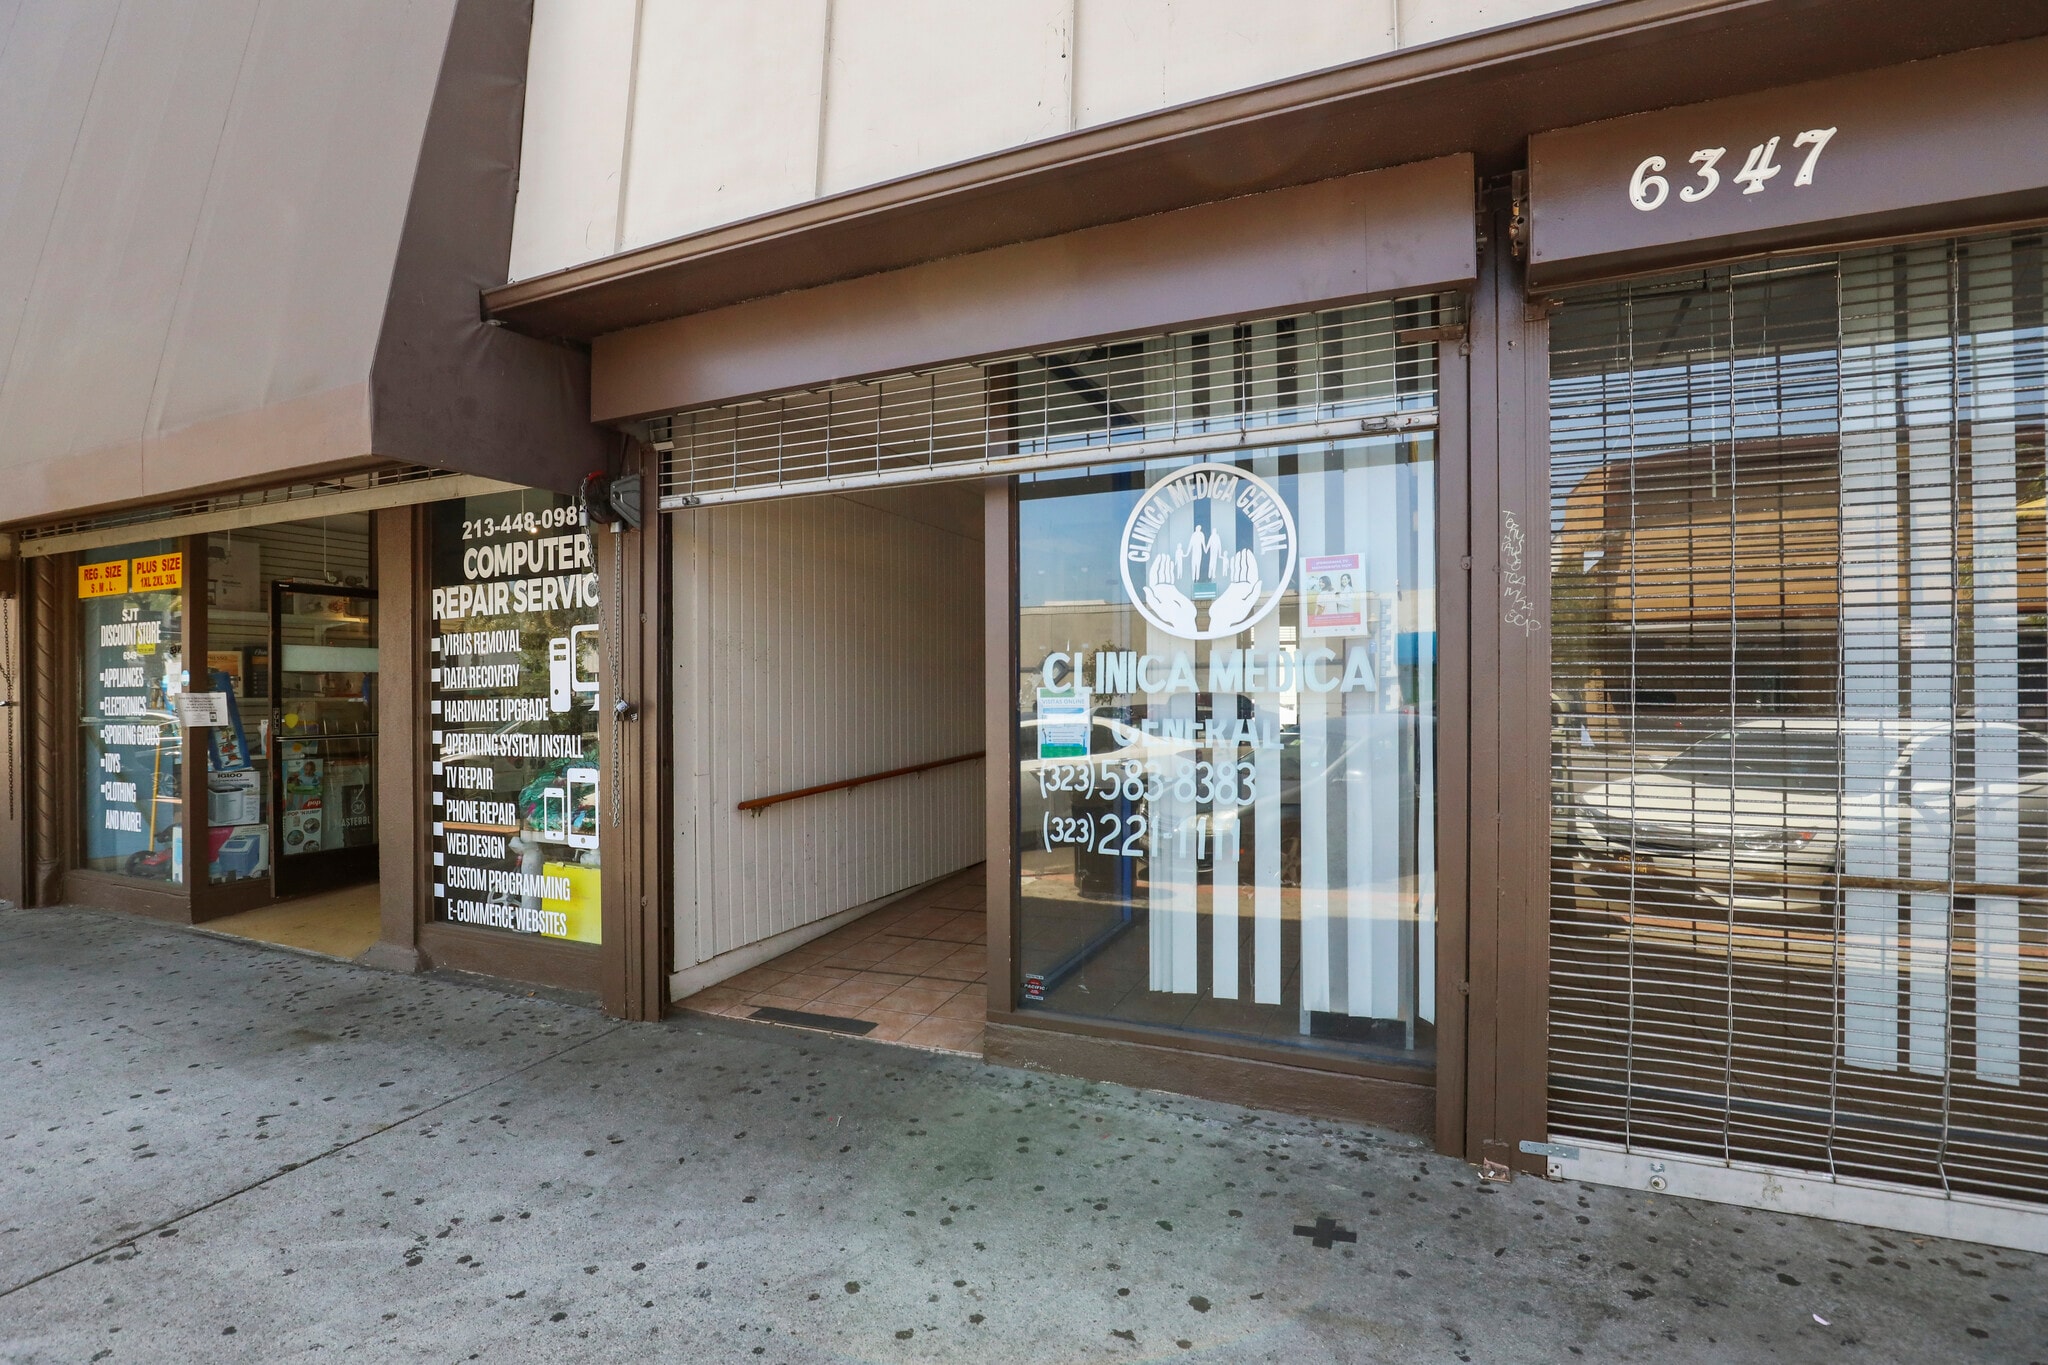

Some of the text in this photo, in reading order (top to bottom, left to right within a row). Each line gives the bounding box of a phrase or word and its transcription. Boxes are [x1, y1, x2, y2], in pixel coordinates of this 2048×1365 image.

[1628, 126, 1838, 212] 6347
[462, 505, 579, 540] 213-448-098
[1127, 471, 1288, 562] CLINICA MEDICA GENERAL
[136, 557, 181, 575] PLUS SIZE
[463, 533, 591, 580] COMPUTER
[105, 565, 121, 579] SIZE
[141, 574, 177, 588] 1XL 2XL 3XL
[432, 582, 510, 620] REPAIR
[122, 607, 139, 622] SJT
[101, 621, 161, 647] DISCOUNT STORE
[443, 629, 522, 656] VIRUS REMOVAL
[104, 667, 144, 688] APPLIANCES
[444, 664, 520, 689] DATA RECOVERY
[1042, 647, 1376, 694] CLINICA MEDICA
[104, 696, 147, 717] ELECTRONICS
[444, 698, 549, 723] HARDWARE UPGRADE
[104, 725, 160, 746] SPORTING GOODS
[445, 733, 584, 759] OPERATING SYSTEM INSTALL
[1112, 717, 1285, 750] GENERAL
[104, 753, 121, 774] TOYS
[445, 766, 494, 790] TV REPAIR
[105, 781, 137, 803] CLOTHING
[105, 809, 142, 832] AND MORE!
[446, 799, 516, 826] PHONE REPAIR
[447, 832, 506, 860] WEB DESIGN
[447, 865, 571, 902] CUSTOM PROGRAMMING
[447, 898, 568, 937] E-COMMERCE WEBSITES
